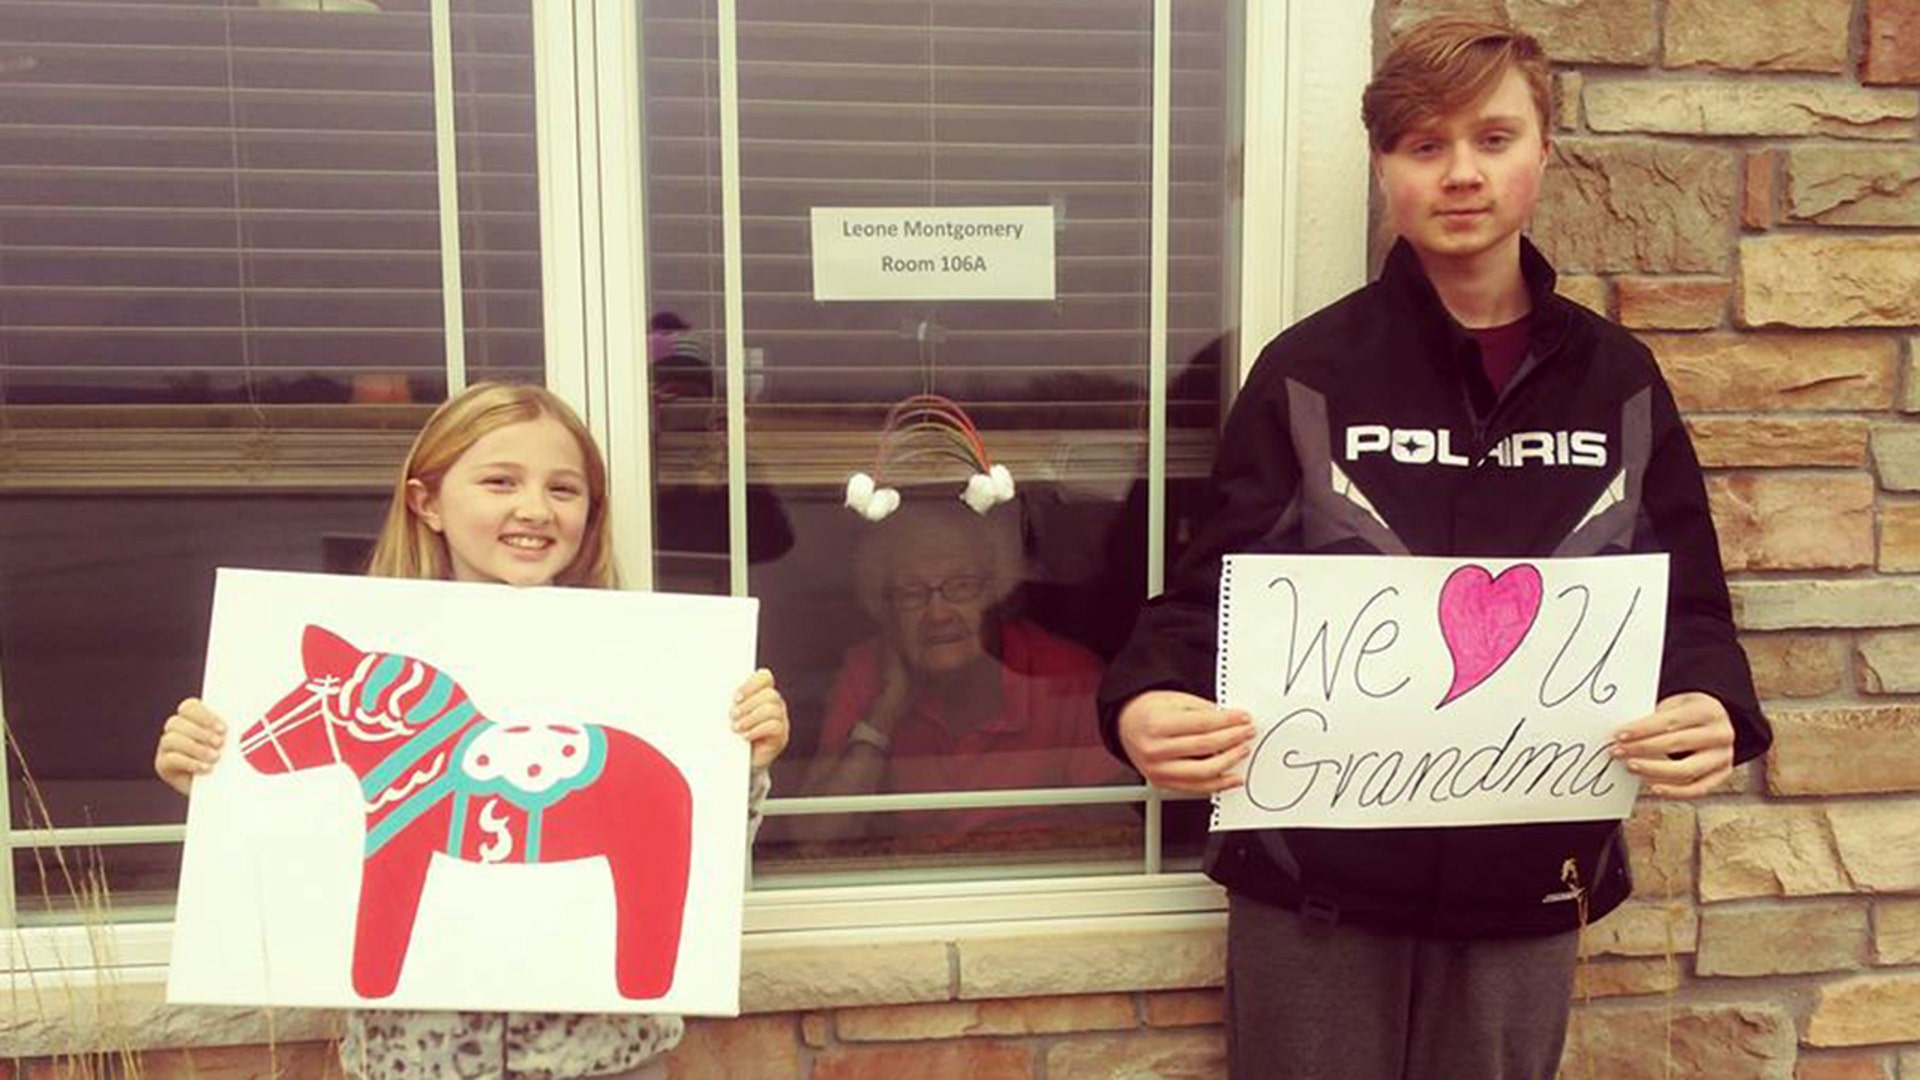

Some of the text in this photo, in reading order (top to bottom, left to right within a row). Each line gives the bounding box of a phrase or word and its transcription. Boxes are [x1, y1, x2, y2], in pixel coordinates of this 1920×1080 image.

[842, 220, 1024, 240] Leone Montgomery
[881, 255, 987, 272] Room 106A
[1345, 425, 1607, 467] POLARIS
[1268, 577, 1642, 708] We U
[1244, 708, 1615, 812] Grandma
